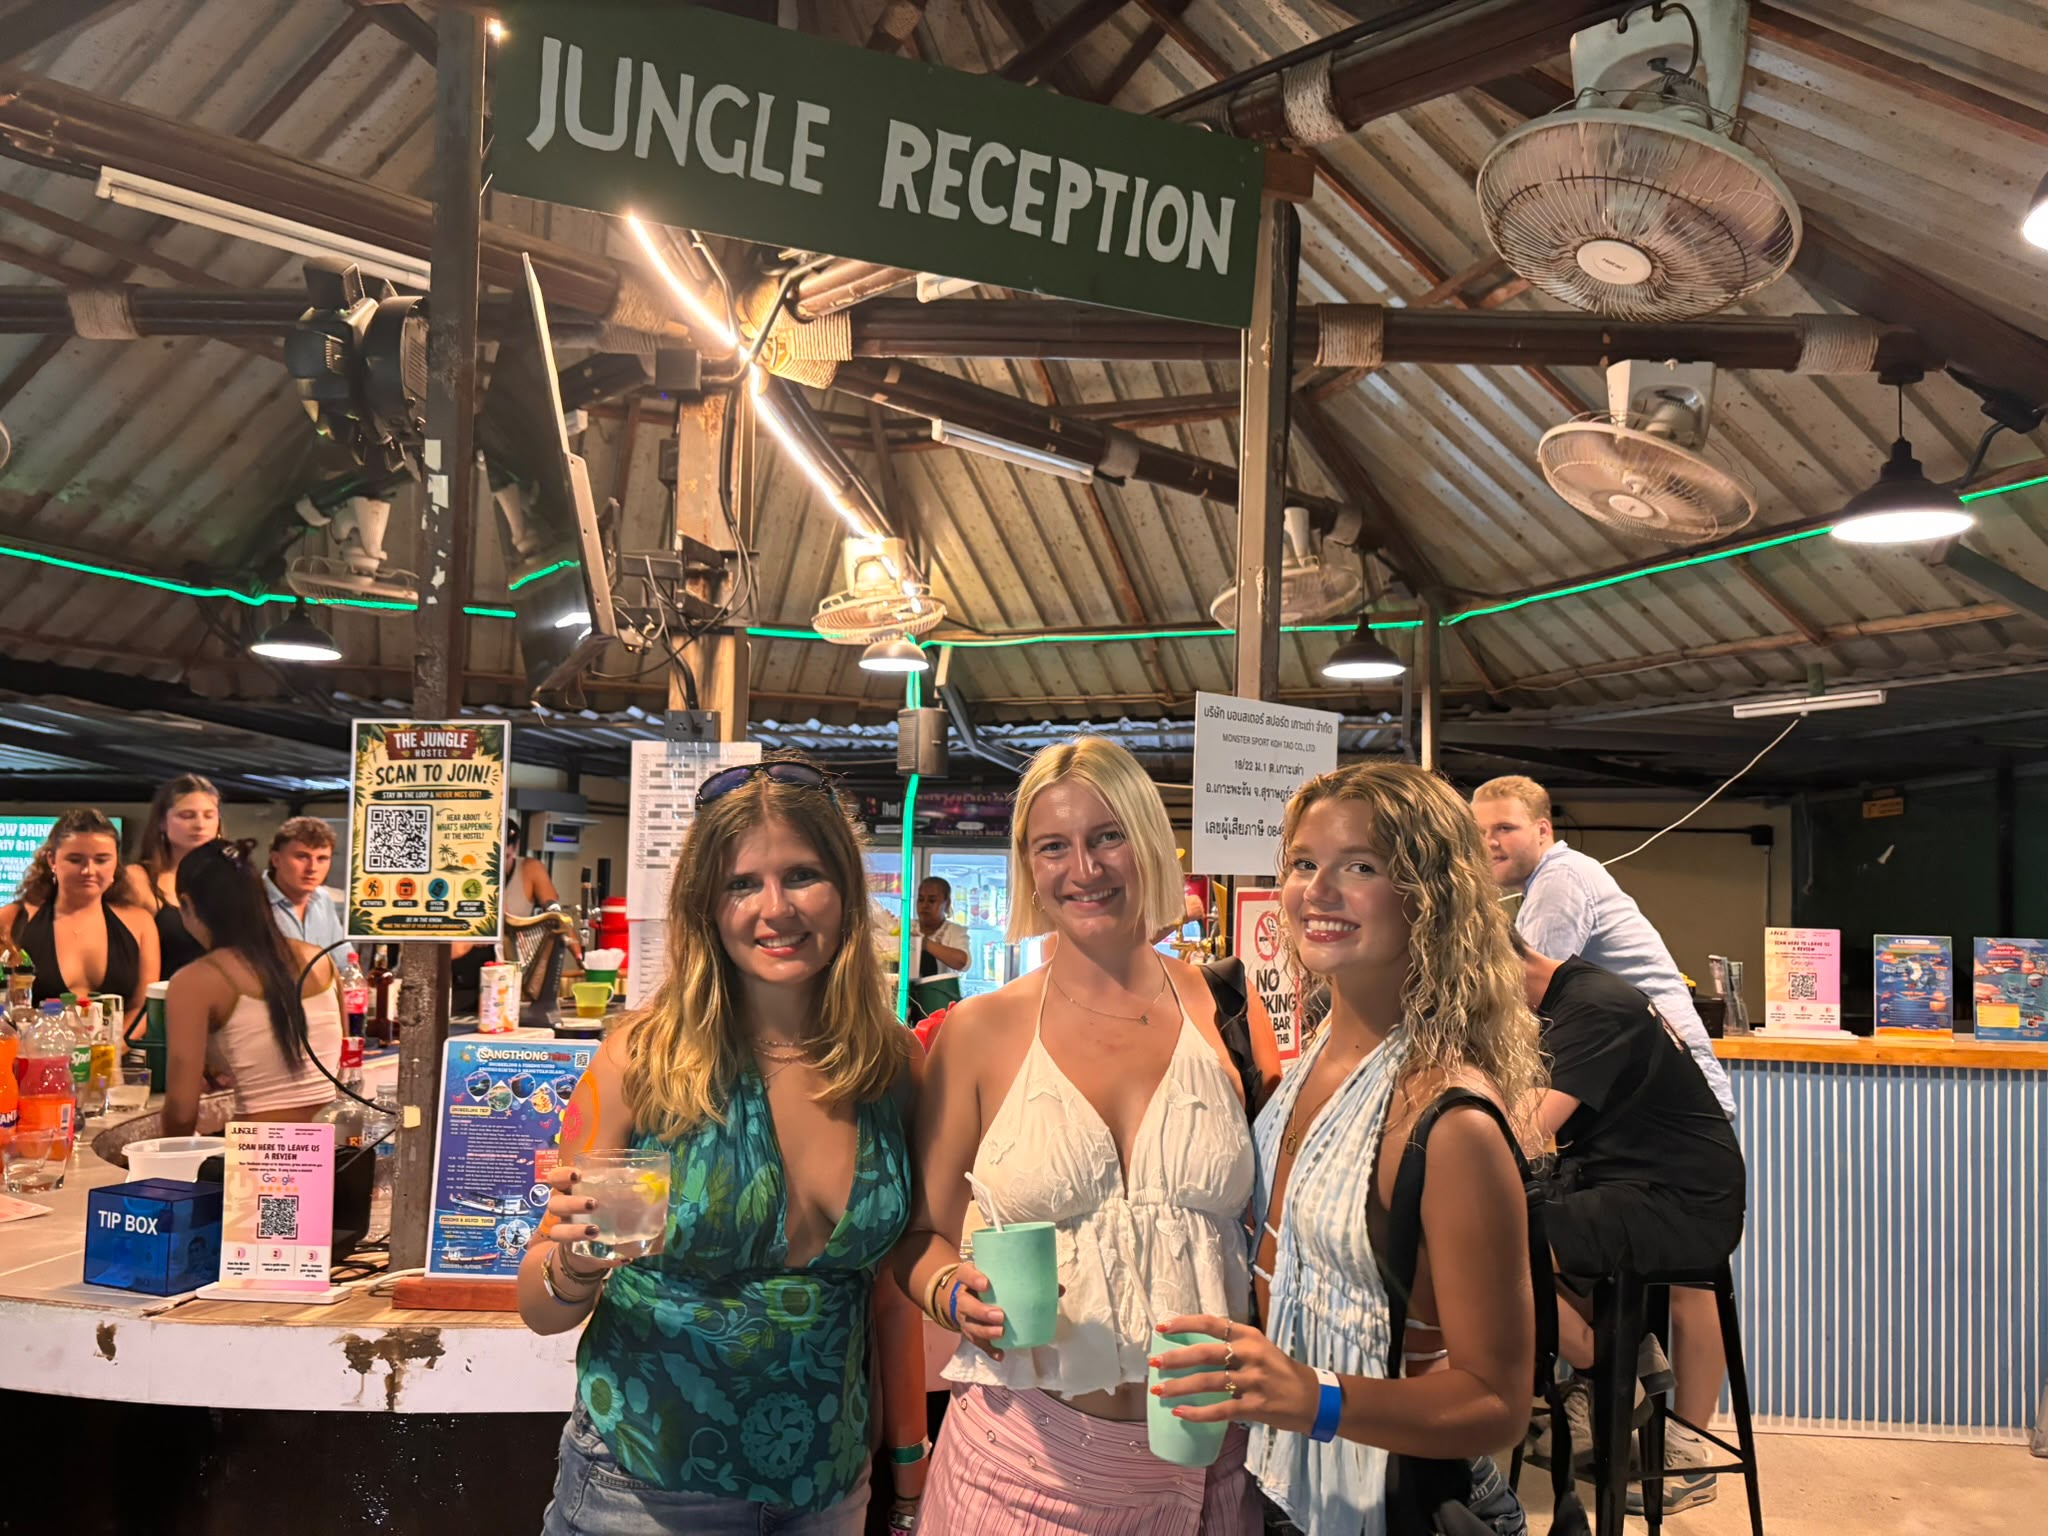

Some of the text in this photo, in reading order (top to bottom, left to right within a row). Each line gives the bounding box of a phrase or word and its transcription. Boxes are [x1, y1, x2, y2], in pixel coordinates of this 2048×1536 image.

[527, 36, 1236, 275] JUNGLE RECEPTION
[393, 732, 469, 749] THE JUNGLE
[1222, 734, 1250, 745] MONSTER
[1251, 737, 1270, 747] SPORT
[1270, 740, 1282, 748] KOH
[1283, 741, 1294, 750] TAO
[415, 749, 448, 757] HOSTEL
[1234, 758, 1253, 771] 18/22
[375, 763, 491, 786] SCAN TO JOIN!
[463, 813, 480, 821] ABOUT
[437, 823, 492, 831] WHAT'S HAPPENING
[463, 832, 485, 840] HOSTEL!
[1256, 968, 1279, 992] NO
[1260, 992, 1298, 1014] KING
[1273, 1016, 1291, 1031] BAR
[1277, 1034, 1290, 1045] THB
[479, 1049, 549, 1061] SANGTHONG
[231, 1127, 258, 1135] JUNGLE
[238, 1143, 256, 1151] SCAN
[287, 1144, 309, 1152] LEAVE
[311, 1144, 320, 1152] US
[264, 1152, 269, 1160] A
[262, 1173, 295, 1186] Google
[98, 1210, 159, 1236] TIP BOX
